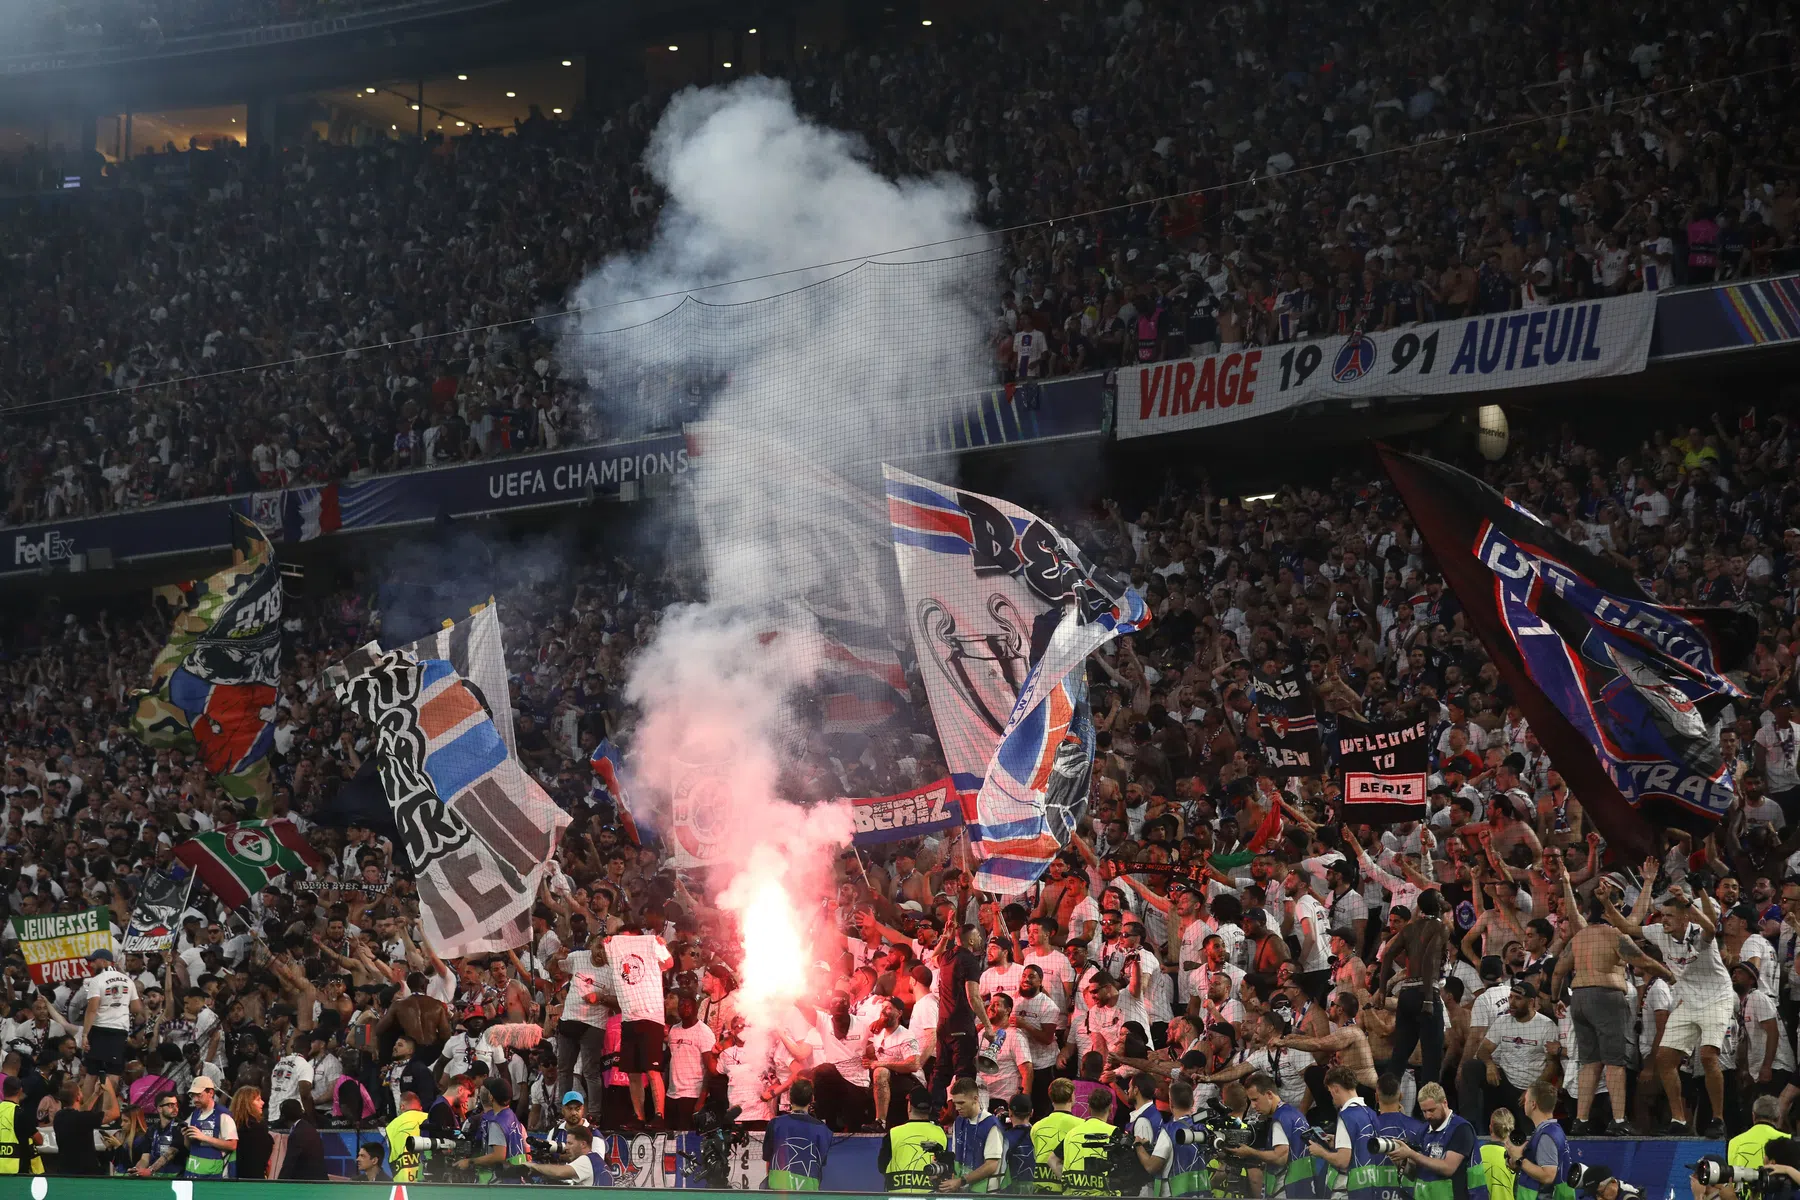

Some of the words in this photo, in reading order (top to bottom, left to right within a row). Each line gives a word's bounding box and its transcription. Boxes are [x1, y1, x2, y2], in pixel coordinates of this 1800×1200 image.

[1139, 350, 1262, 420] VIRAGE
[1279, 344, 1322, 392] 19
[1387, 329, 1440, 375] 91
[1449, 304, 1602, 375] AUTEUIL
[489, 469, 547, 499] UEFA
[553, 449, 689, 490] CHAMPIONS
[14, 530, 75, 565] FedEx
[1339, 720, 1427, 755] WELCOME
[1264, 746, 1311, 769] REW
[1372, 752, 1396, 771] TO
[1360, 782, 1412, 795] BERIZ
[853, 786, 952, 833] BERIZ
[20, 910, 99, 941] JEUNESSE
[41, 958, 92, 984] PARIS
[188, 1158, 200, 1171] TV
[395, 1152, 421, 1171] STEW
[893, 1173, 934, 1188] STEWA
